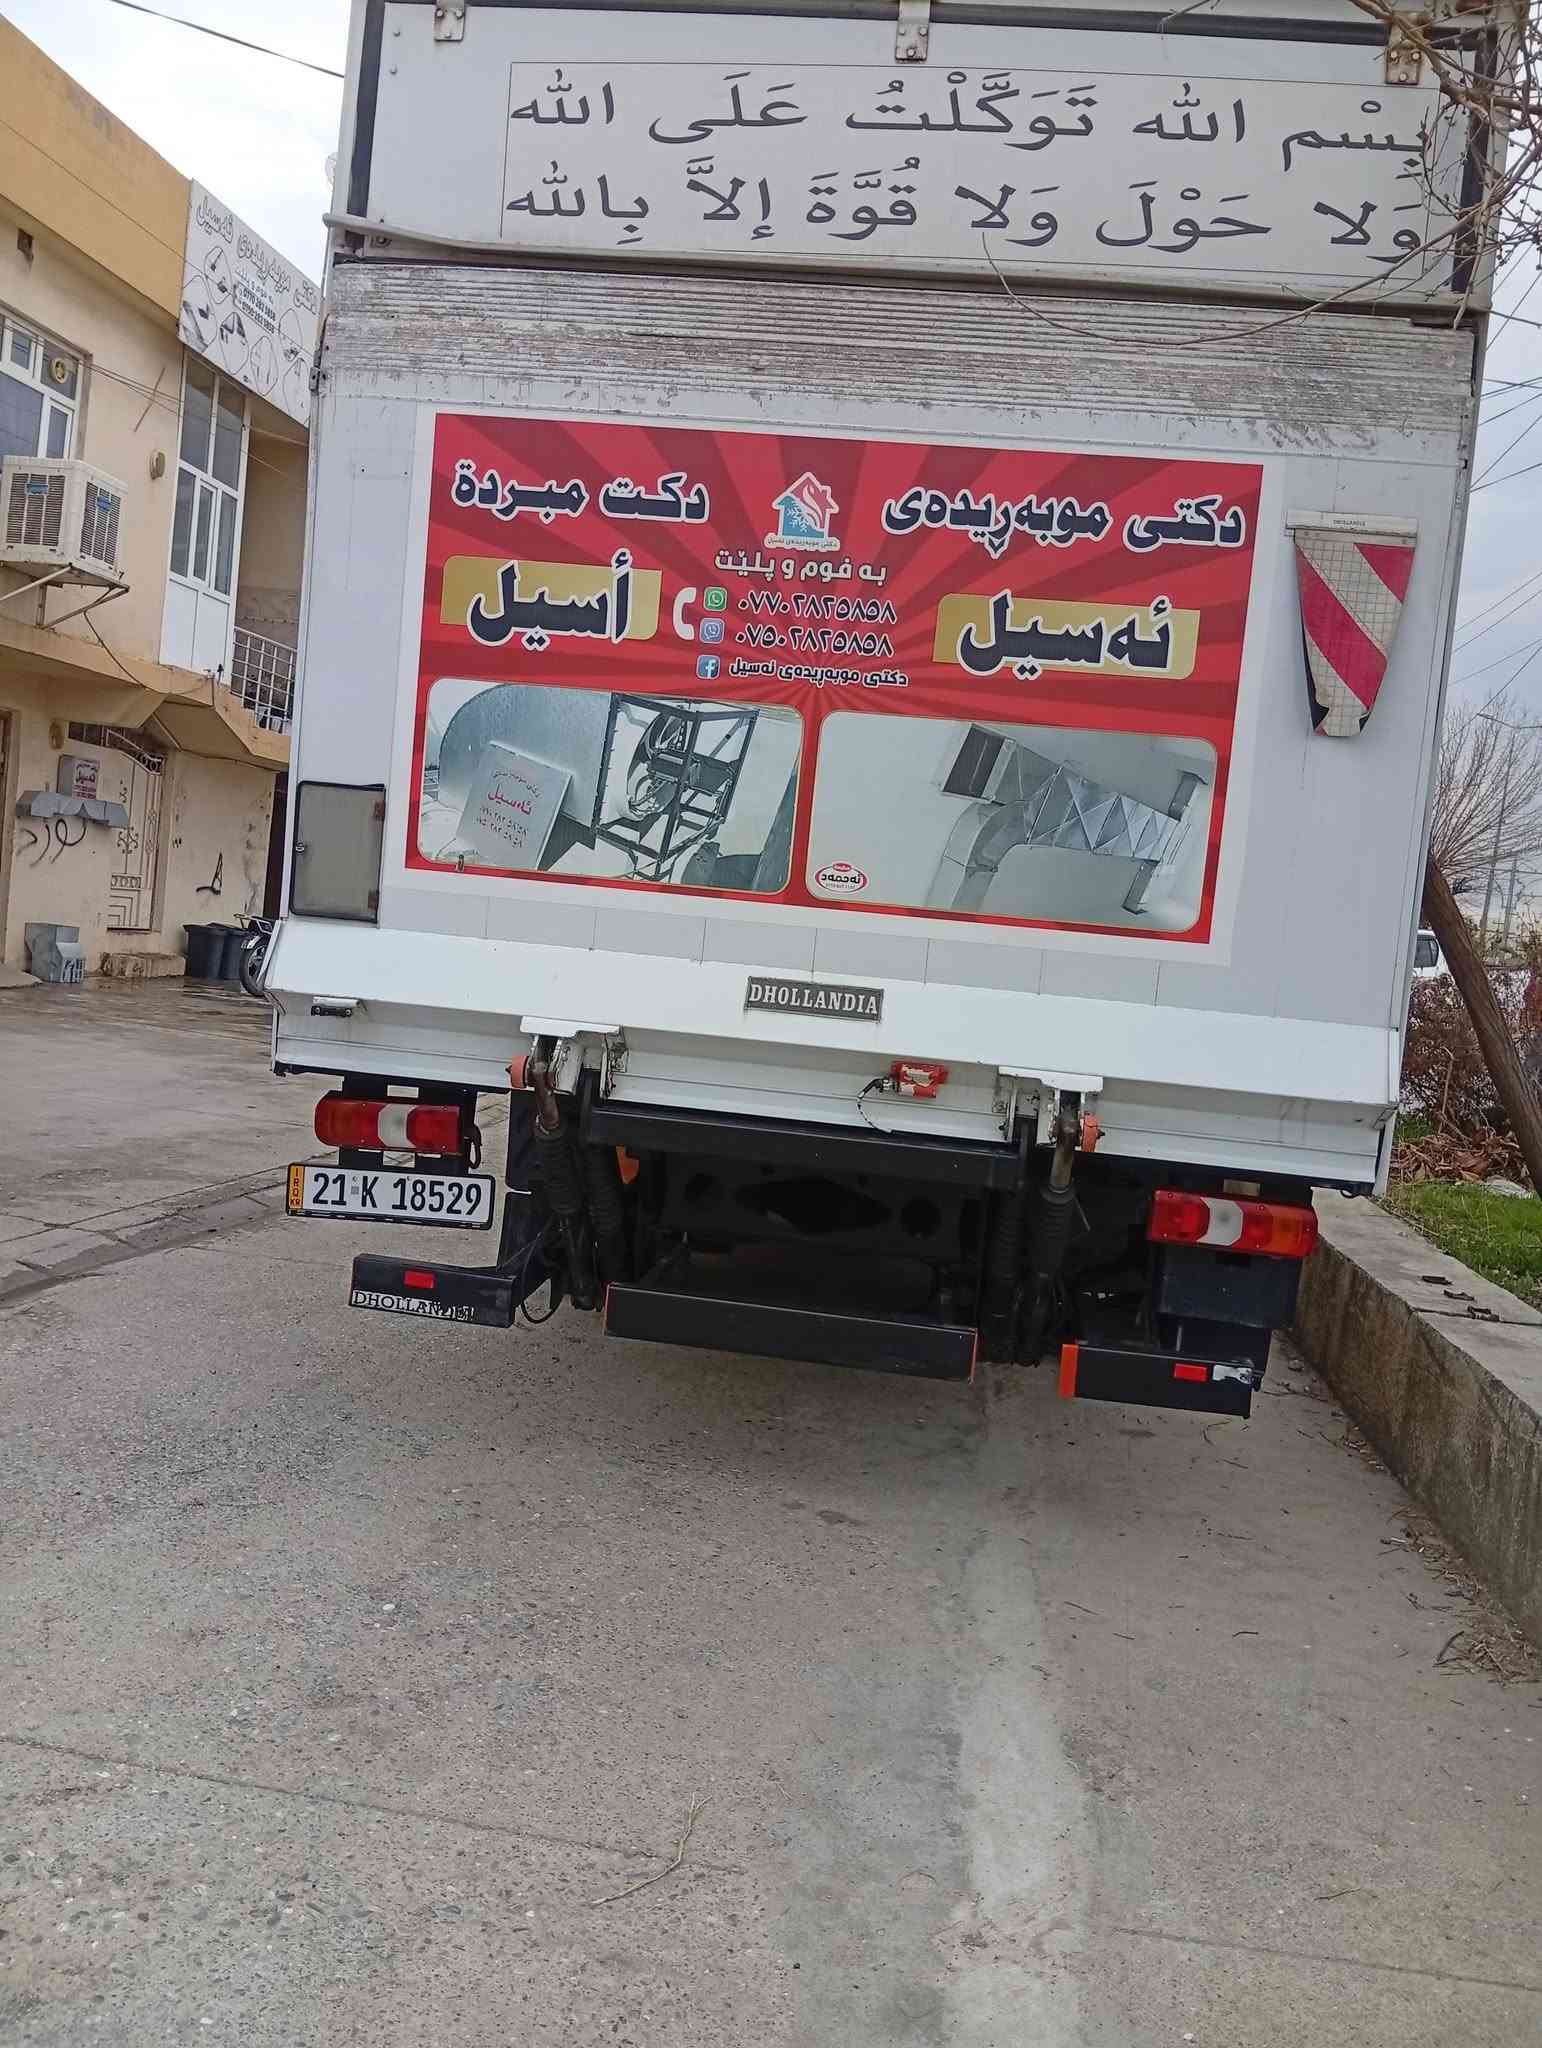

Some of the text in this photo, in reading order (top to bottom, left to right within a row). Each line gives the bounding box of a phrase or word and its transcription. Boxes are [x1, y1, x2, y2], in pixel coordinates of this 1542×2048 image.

[451, 459, 589, 524] مبردة
[1124, 494, 1246, 553] دکتی
[781, 558, 795, 580] و
[800, 557, 852, 583] فوم
[467, 548, 632, 650] أسيل
[957, 589, 1174, 680] ئەسیل
[749, 983, 878, 1014] DHOLLANDIA
[312, 1172, 482, 1216] 21 K 18529
